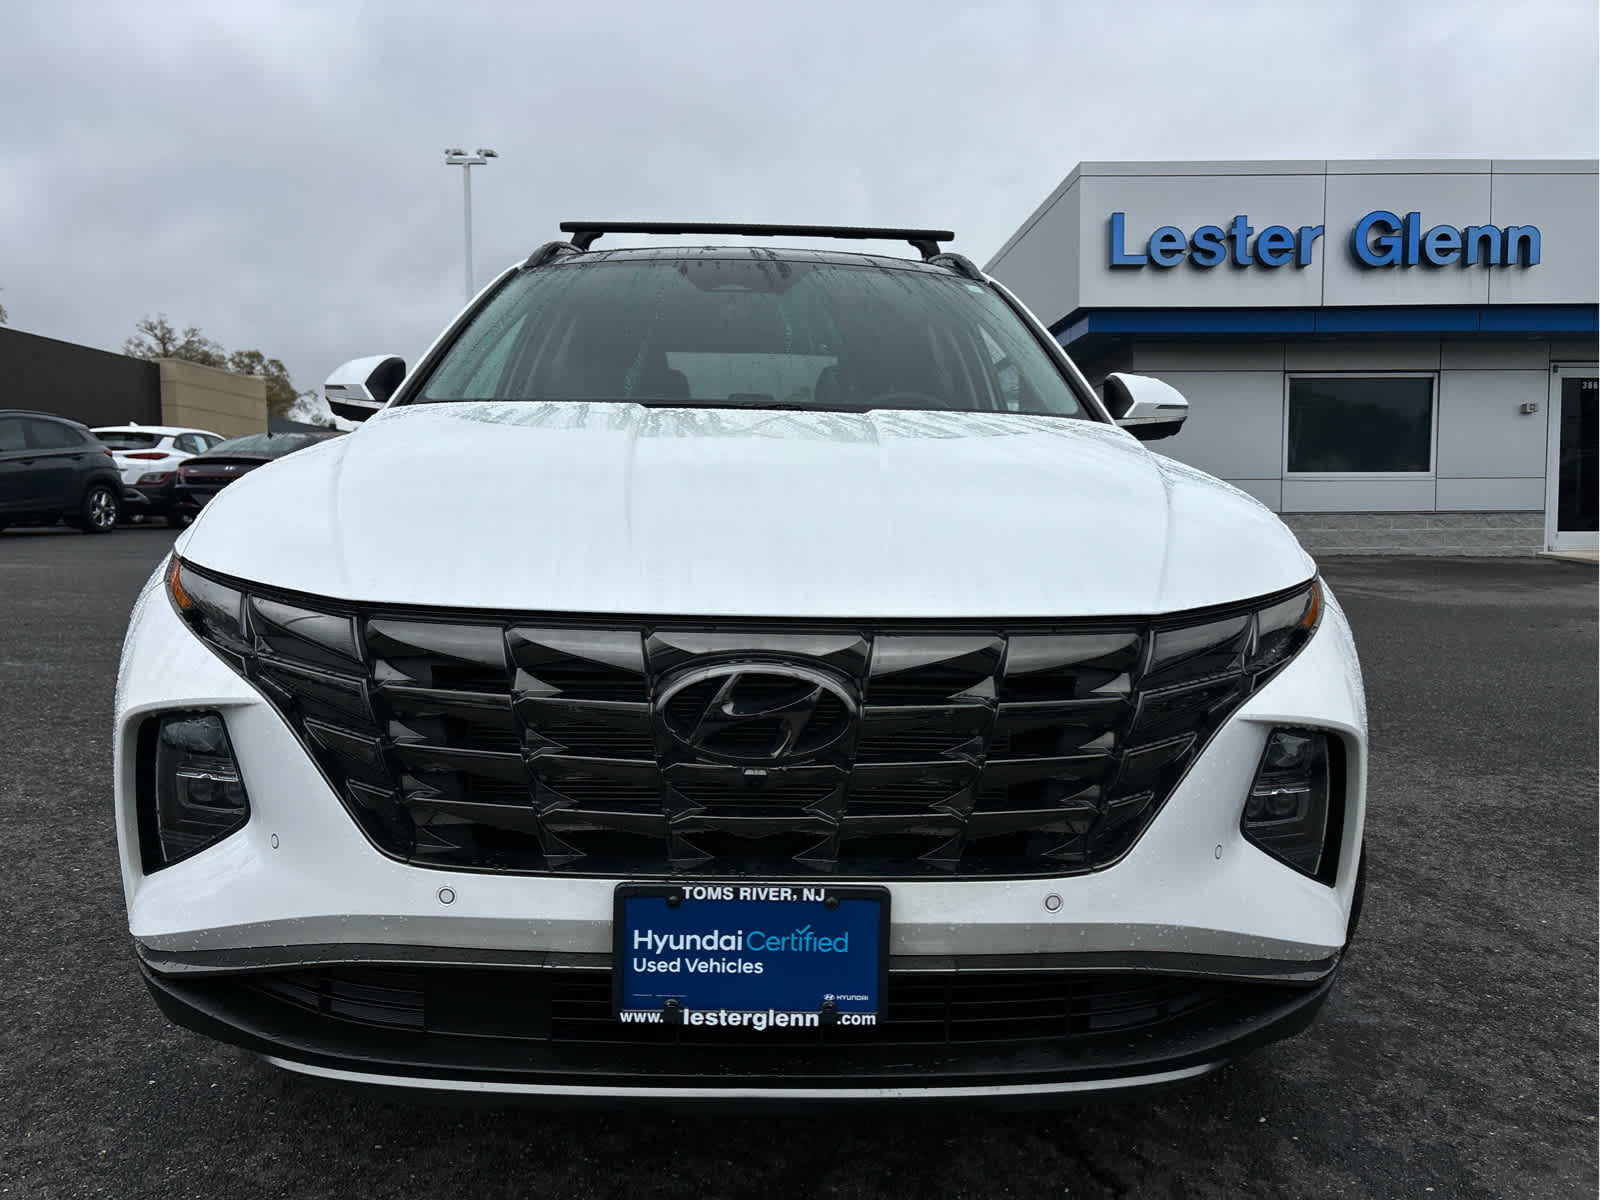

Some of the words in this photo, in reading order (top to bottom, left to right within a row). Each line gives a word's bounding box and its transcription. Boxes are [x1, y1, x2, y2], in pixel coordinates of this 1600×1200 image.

[1108, 211, 1324, 269] Lester
[1350, 210, 1541, 268] Glenn
[683, 886, 734, 901] TOMS
[740, 887, 798, 902] RIVER,
[803, 888, 826, 902] NJ
[633, 929, 743, 955] Hyundai
[746, 924, 849, 953] Certified
[633, 957, 681, 973] Used
[685, 958, 764, 974] Vehicles
[620, 1011, 664, 1023] www.
[683, 1008, 819, 1030] lesterglenn
[837, 1013, 876, 1026] .com
